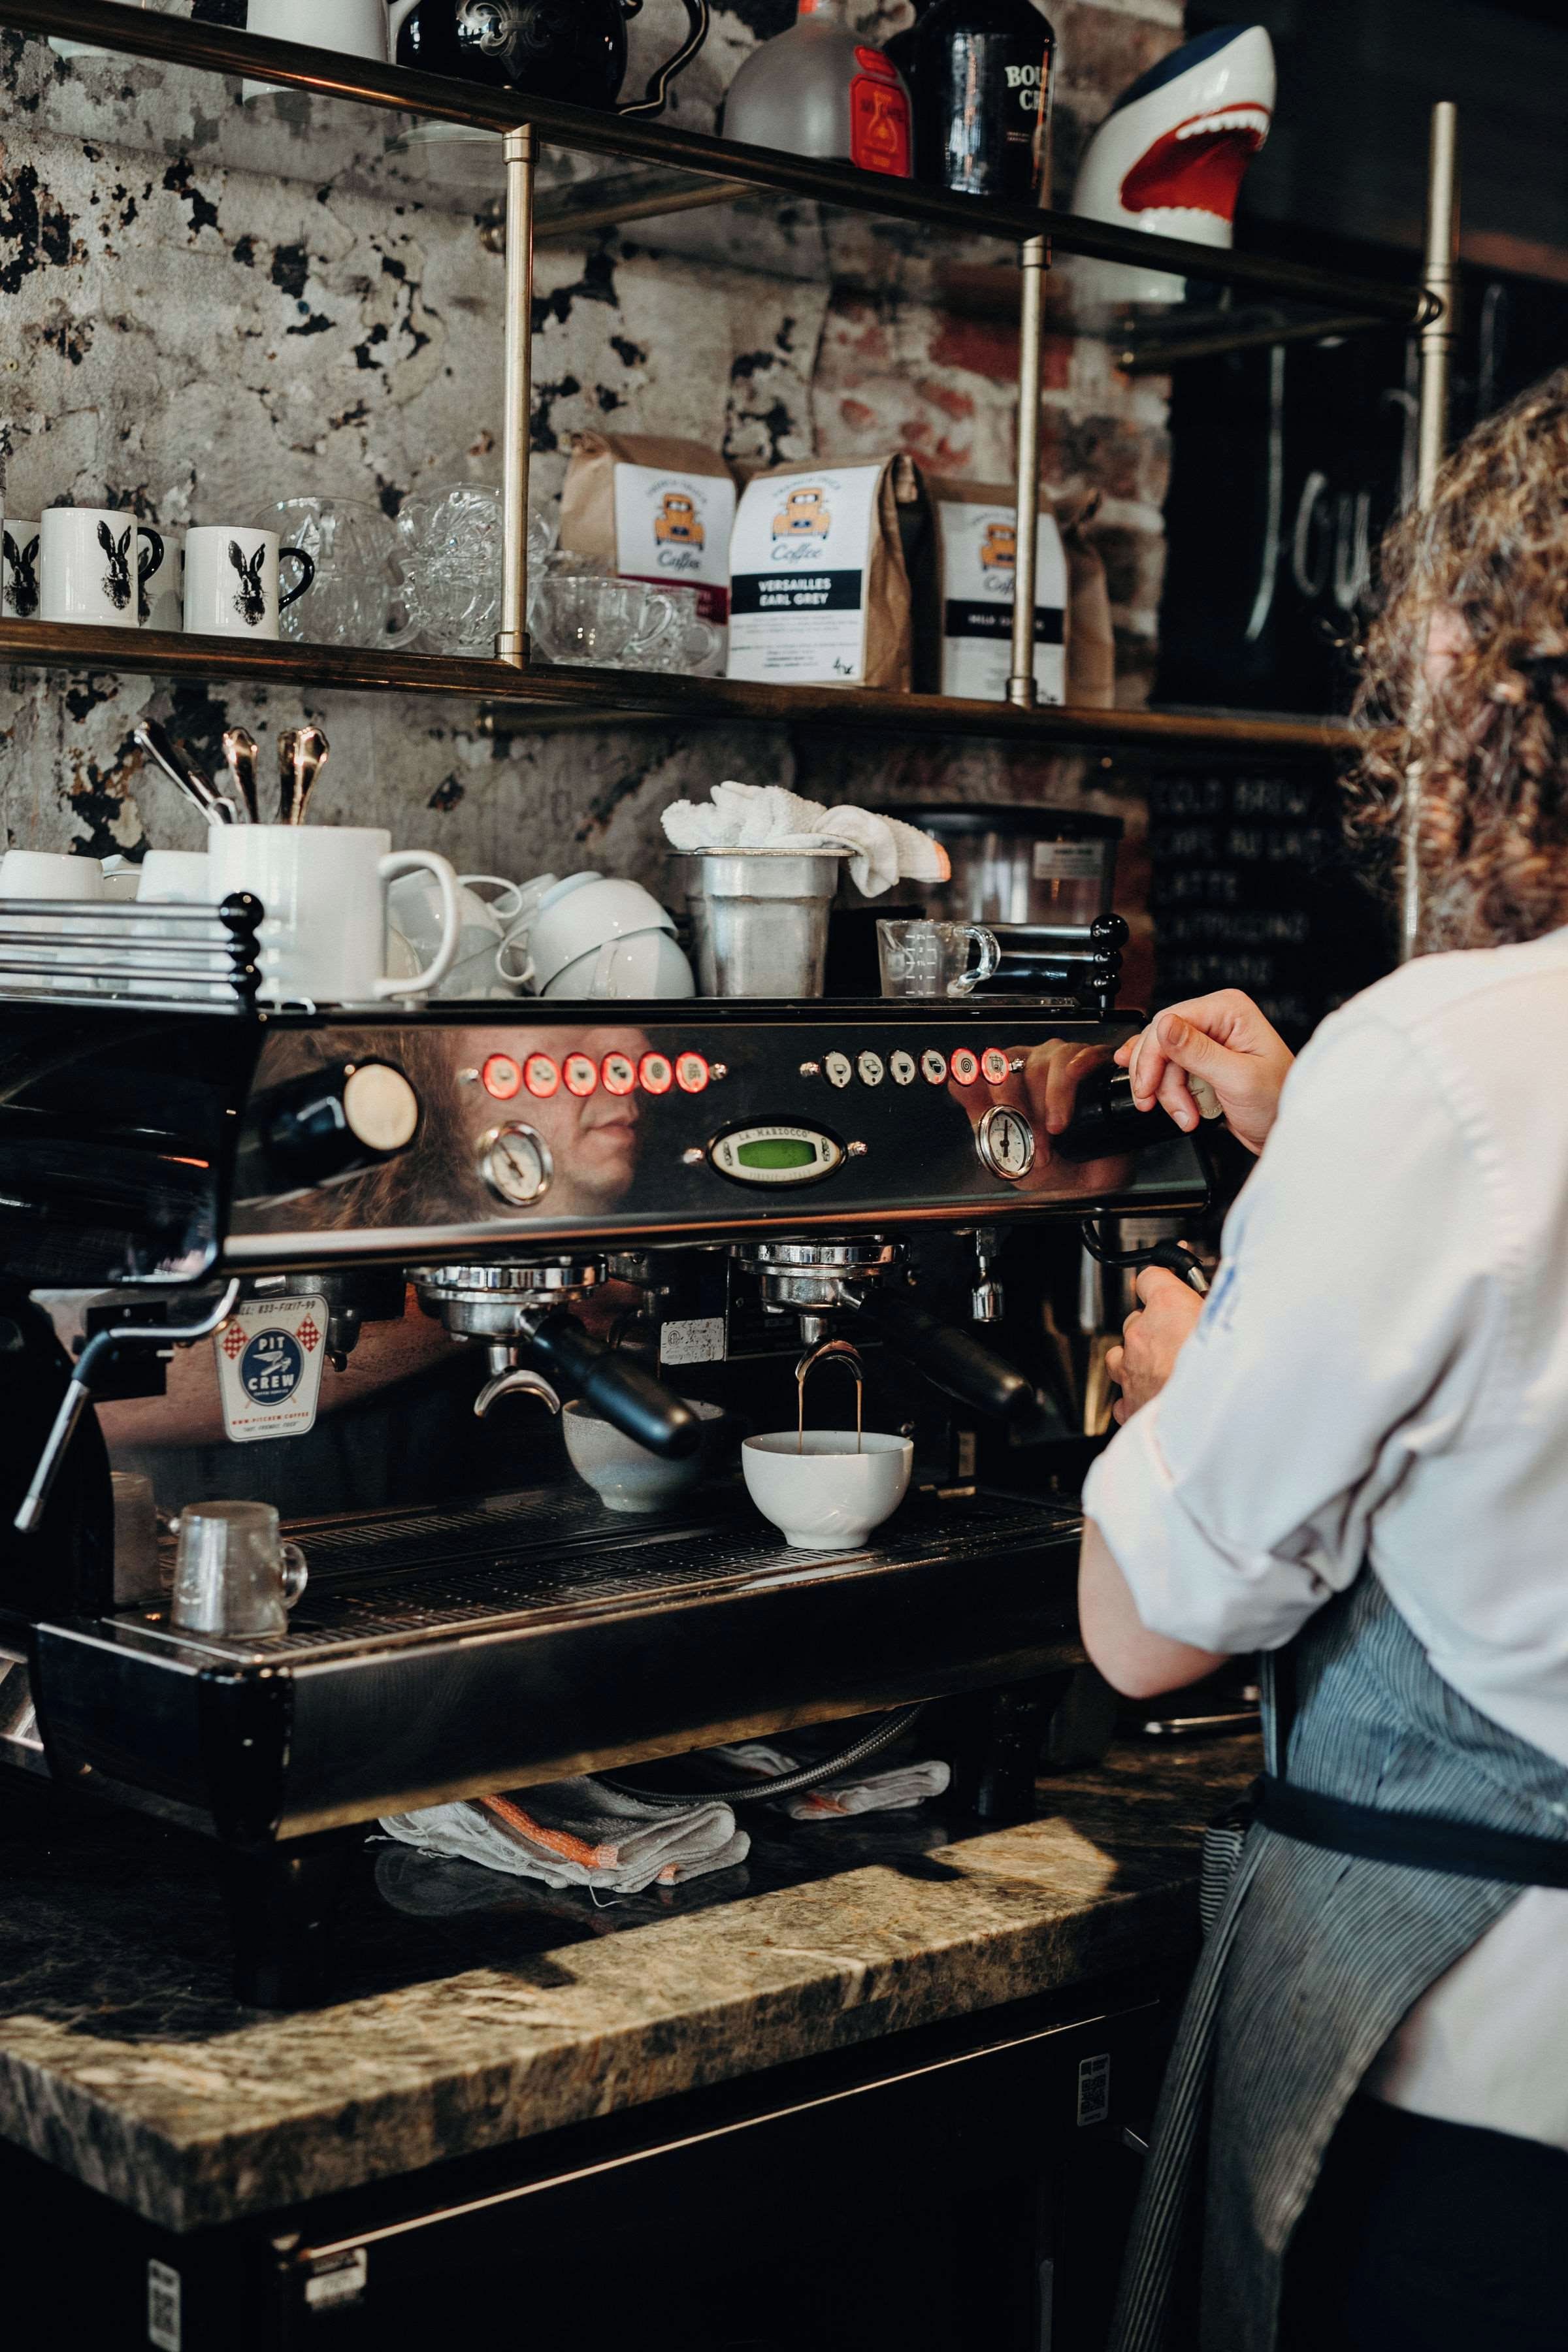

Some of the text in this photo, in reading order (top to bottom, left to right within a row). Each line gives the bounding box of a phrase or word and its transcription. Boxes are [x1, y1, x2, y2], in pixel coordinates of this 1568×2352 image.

[771, 543, 823, 564] Coffee
[759, 578, 832, 592] VERSAILLES
[759, 592, 829, 607] EARL GREY
[259, 1336, 285, 1351] PIT
[248, 1373, 295, 1390] CREW
